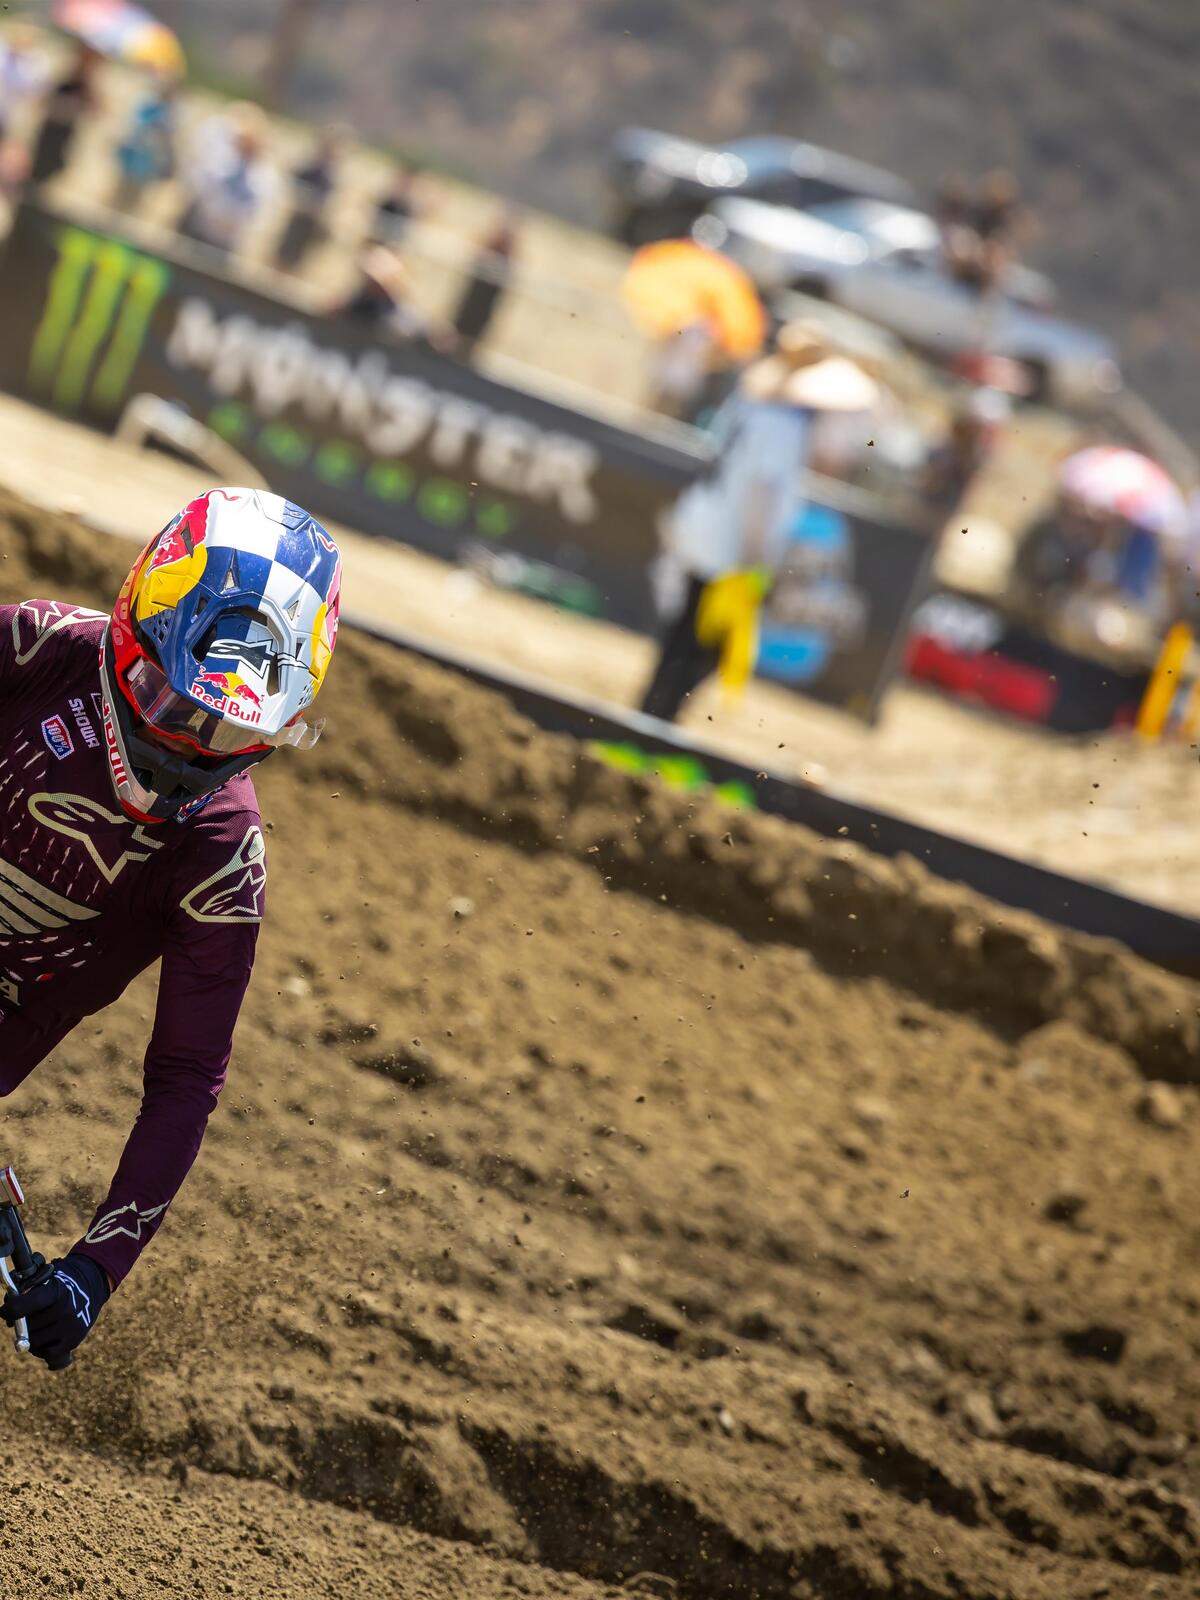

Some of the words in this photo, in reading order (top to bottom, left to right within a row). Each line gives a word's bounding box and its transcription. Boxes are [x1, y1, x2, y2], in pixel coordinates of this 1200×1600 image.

[68, 698, 100, 748] SHOWA
[190, 682, 226, 712] Red
[225, 697, 262, 725] Bull
[47, 721, 70, 754] 100%
